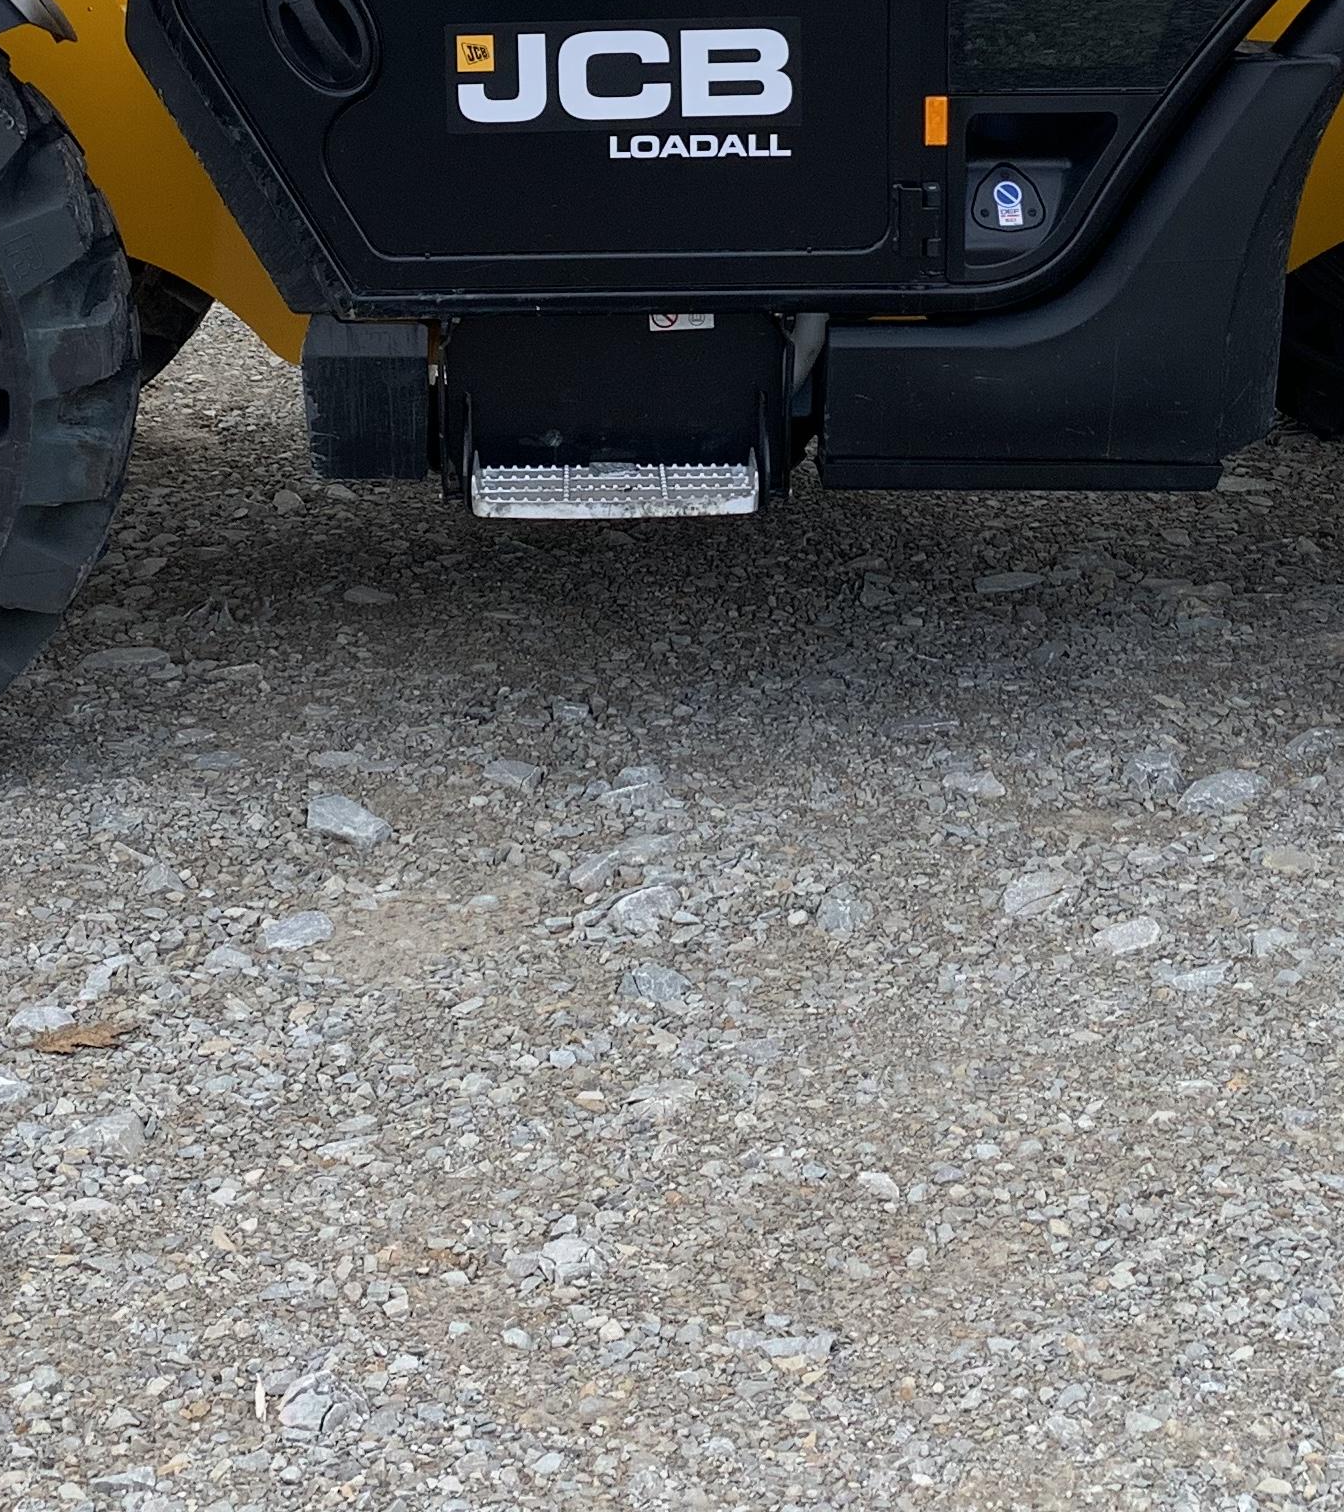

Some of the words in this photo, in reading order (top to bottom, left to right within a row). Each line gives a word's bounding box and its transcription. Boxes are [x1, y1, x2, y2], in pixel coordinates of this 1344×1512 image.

[465, 44, 489, 63] JCB
[457, 28, 793, 124] JCB
[609, 133, 792, 159] LOADALL
